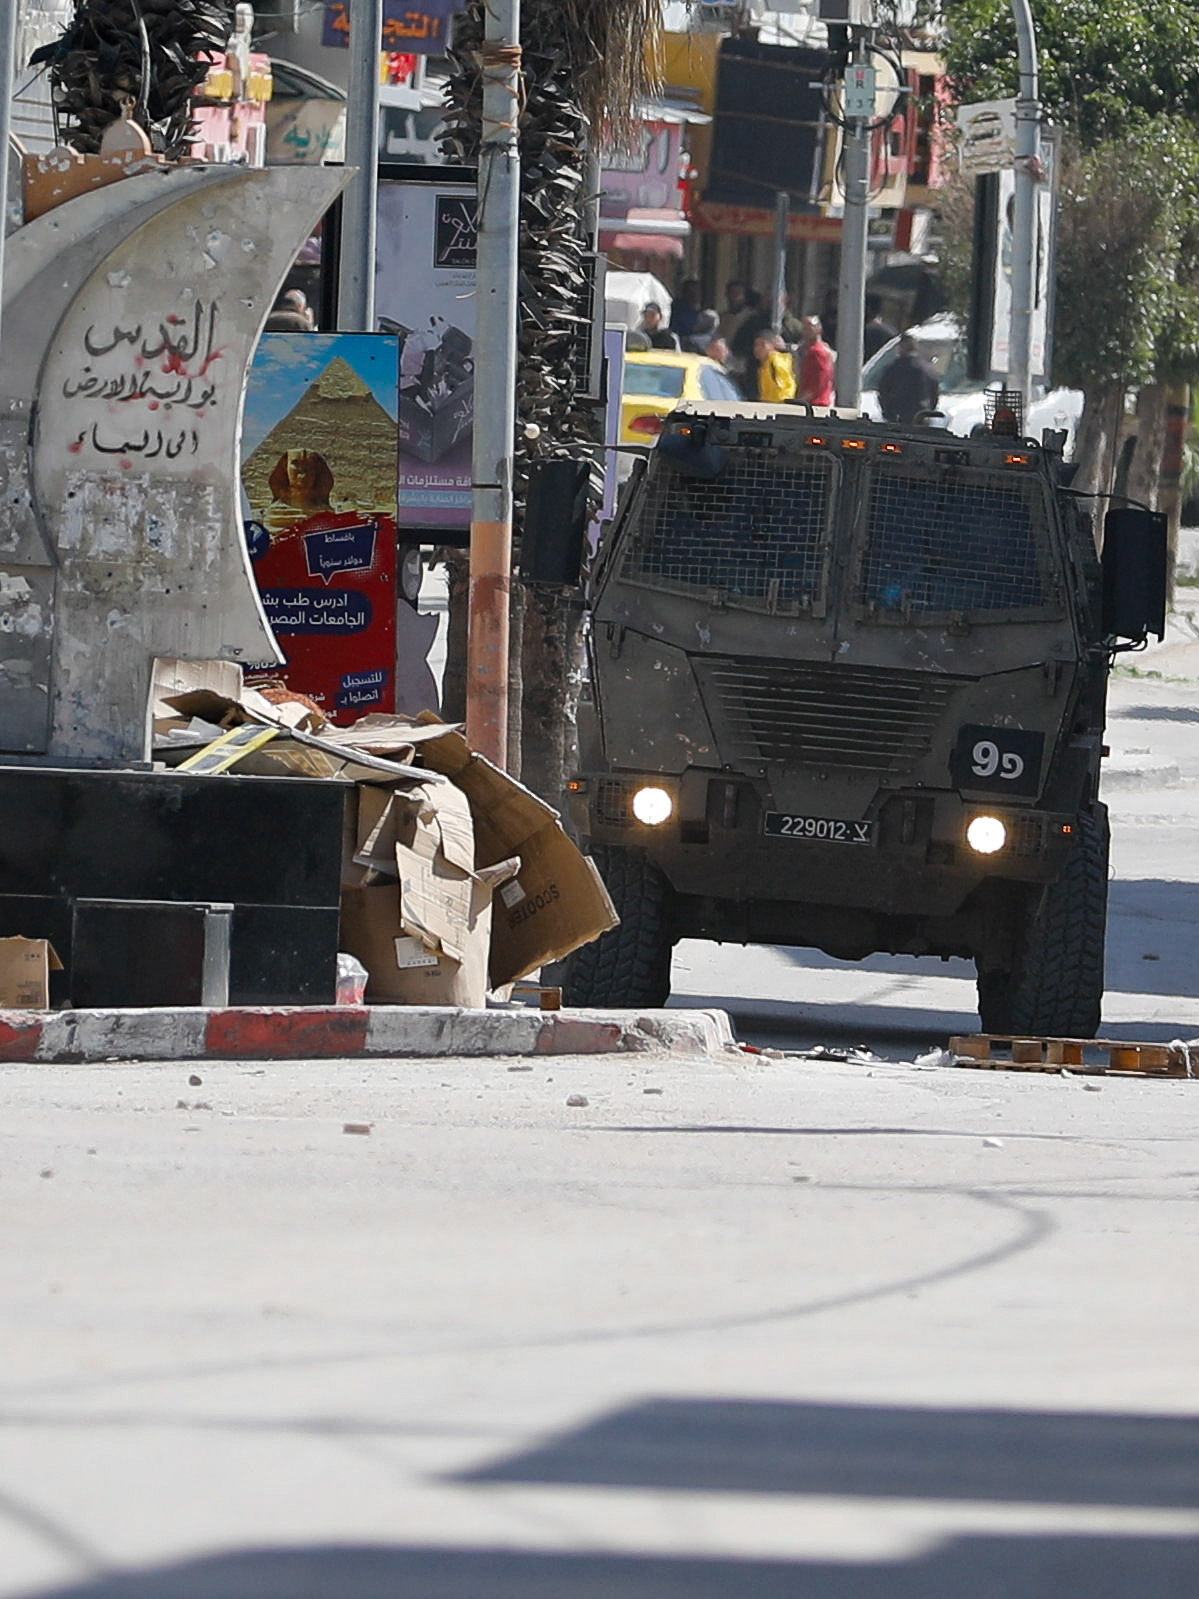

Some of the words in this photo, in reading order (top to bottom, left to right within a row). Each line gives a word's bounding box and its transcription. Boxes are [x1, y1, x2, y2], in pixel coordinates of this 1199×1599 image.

[84, 299, 219, 361] القدس
[455, 474, 472, 488] افة
[283, 593, 310, 607] طب
[313, 593, 348, 609] ادرس
[309, 612, 365, 628] الجامعات
[343, 671, 383, 688] للتسجيل
